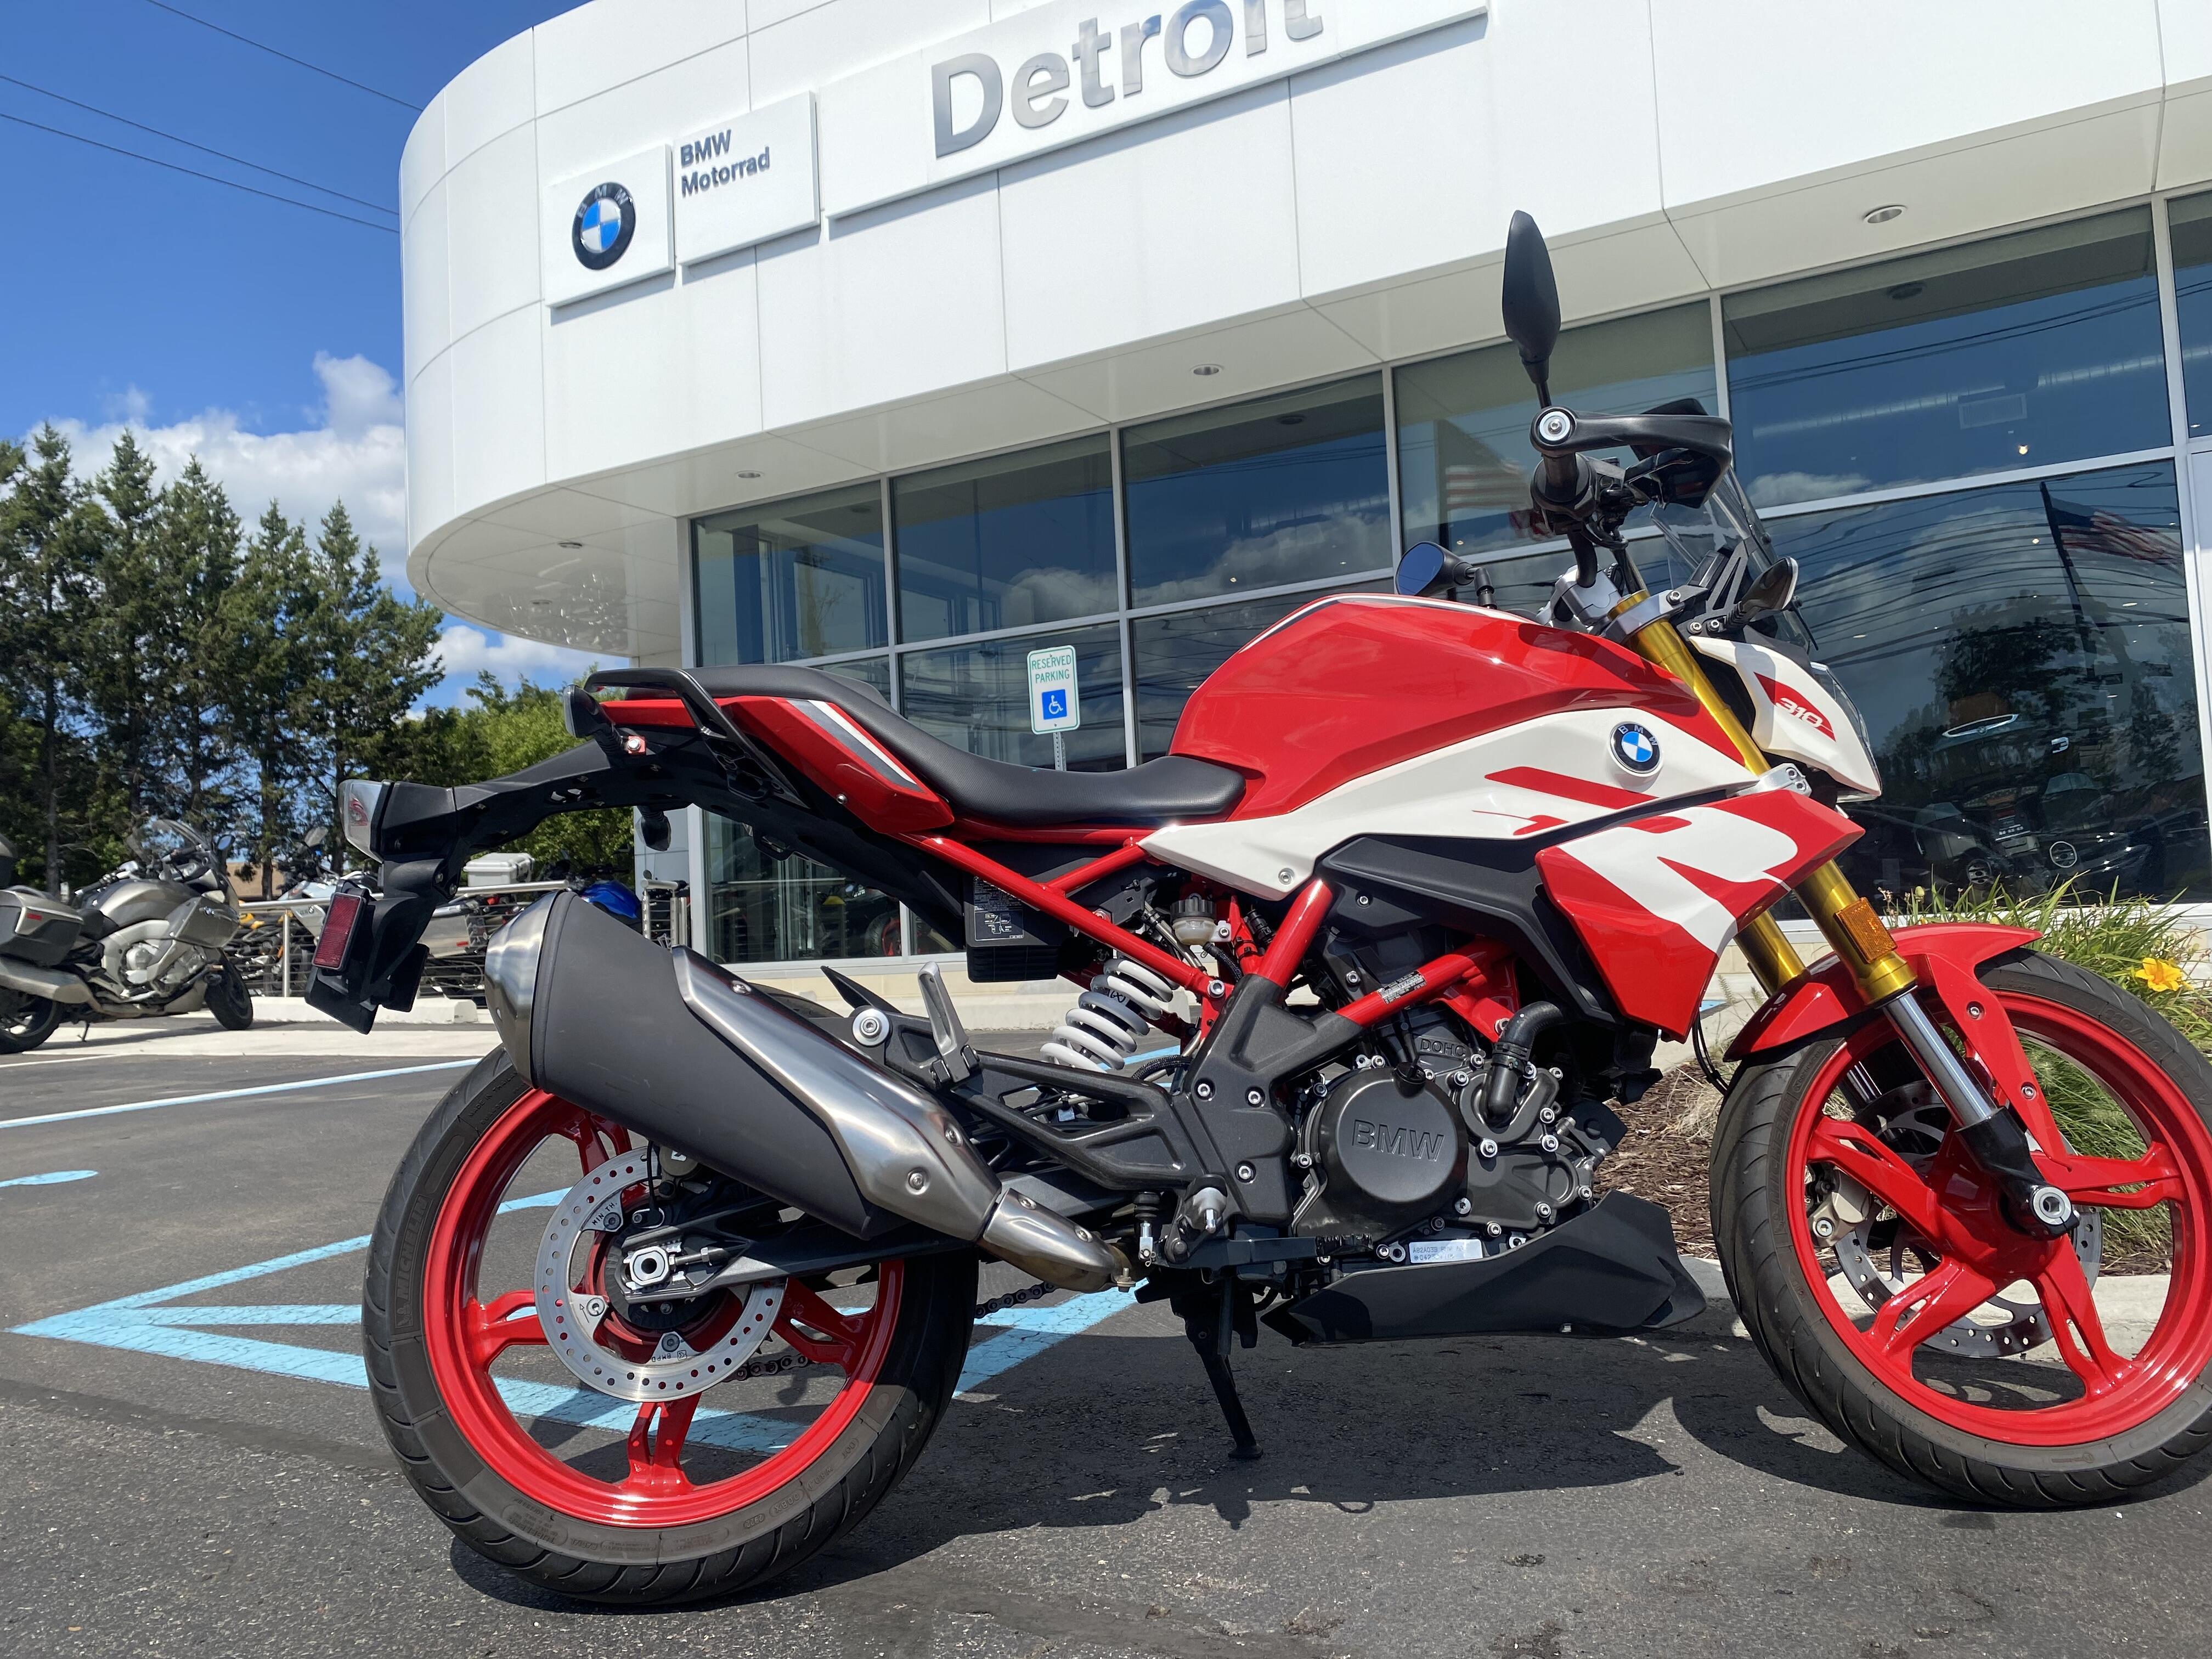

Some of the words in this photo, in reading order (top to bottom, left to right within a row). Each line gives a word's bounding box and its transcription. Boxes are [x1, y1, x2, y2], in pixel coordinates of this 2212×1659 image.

[680, 129, 732, 168] BMW
[681, 146, 770, 198] Motorrad
[1031, 654, 1071, 670] RESERVED
[1035, 669, 1070, 684] PARKING
[1775, 697, 1824, 728] 310
[1618, 724, 1659, 746] BMW
[1420, 1039, 1467, 1057] DOHC
[1352, 1119, 1444, 1162] BMW
[1768, 1097, 1794, 1202] MICHELIN
[591, 1213, 605, 1226] MIN
[397, 1195, 429, 1301] MICHELIN
